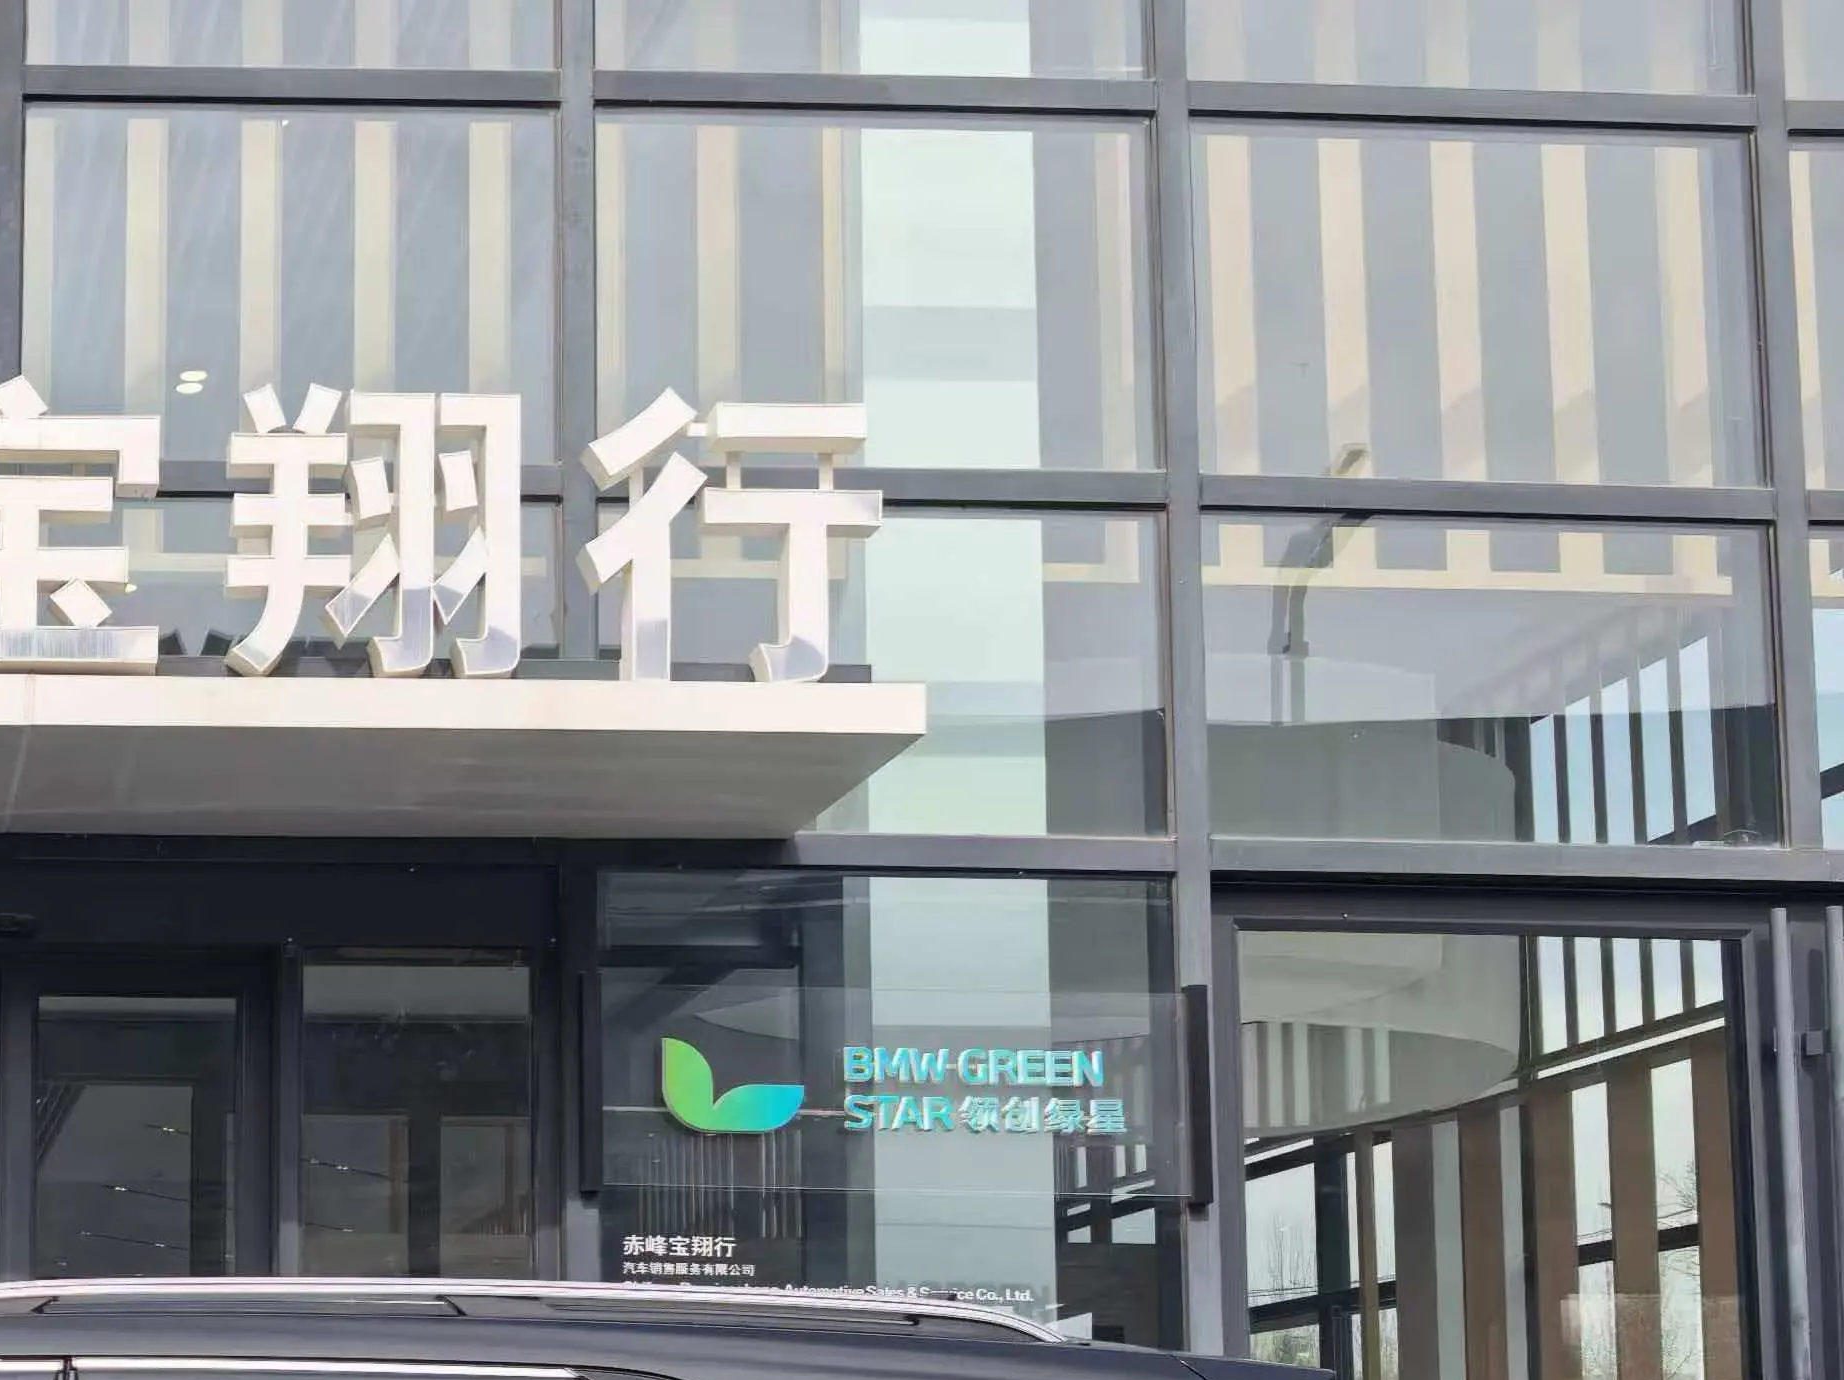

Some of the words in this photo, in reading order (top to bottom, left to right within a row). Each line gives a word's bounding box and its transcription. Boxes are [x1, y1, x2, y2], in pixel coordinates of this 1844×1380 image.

[844, 1095, 954, 1132] STAR
[958, 1095, 1128, 1135] 领创绿星
[622, 1234, 737, 1258] 赤峰宝翔行
[622, 1261, 756, 1277] 汽车销售服务有限公司
[865, 1285, 905, 1298] Sales
[907, 1286, 917, 1299] &
[1005, 1288, 1035, 1302] Ltd.
